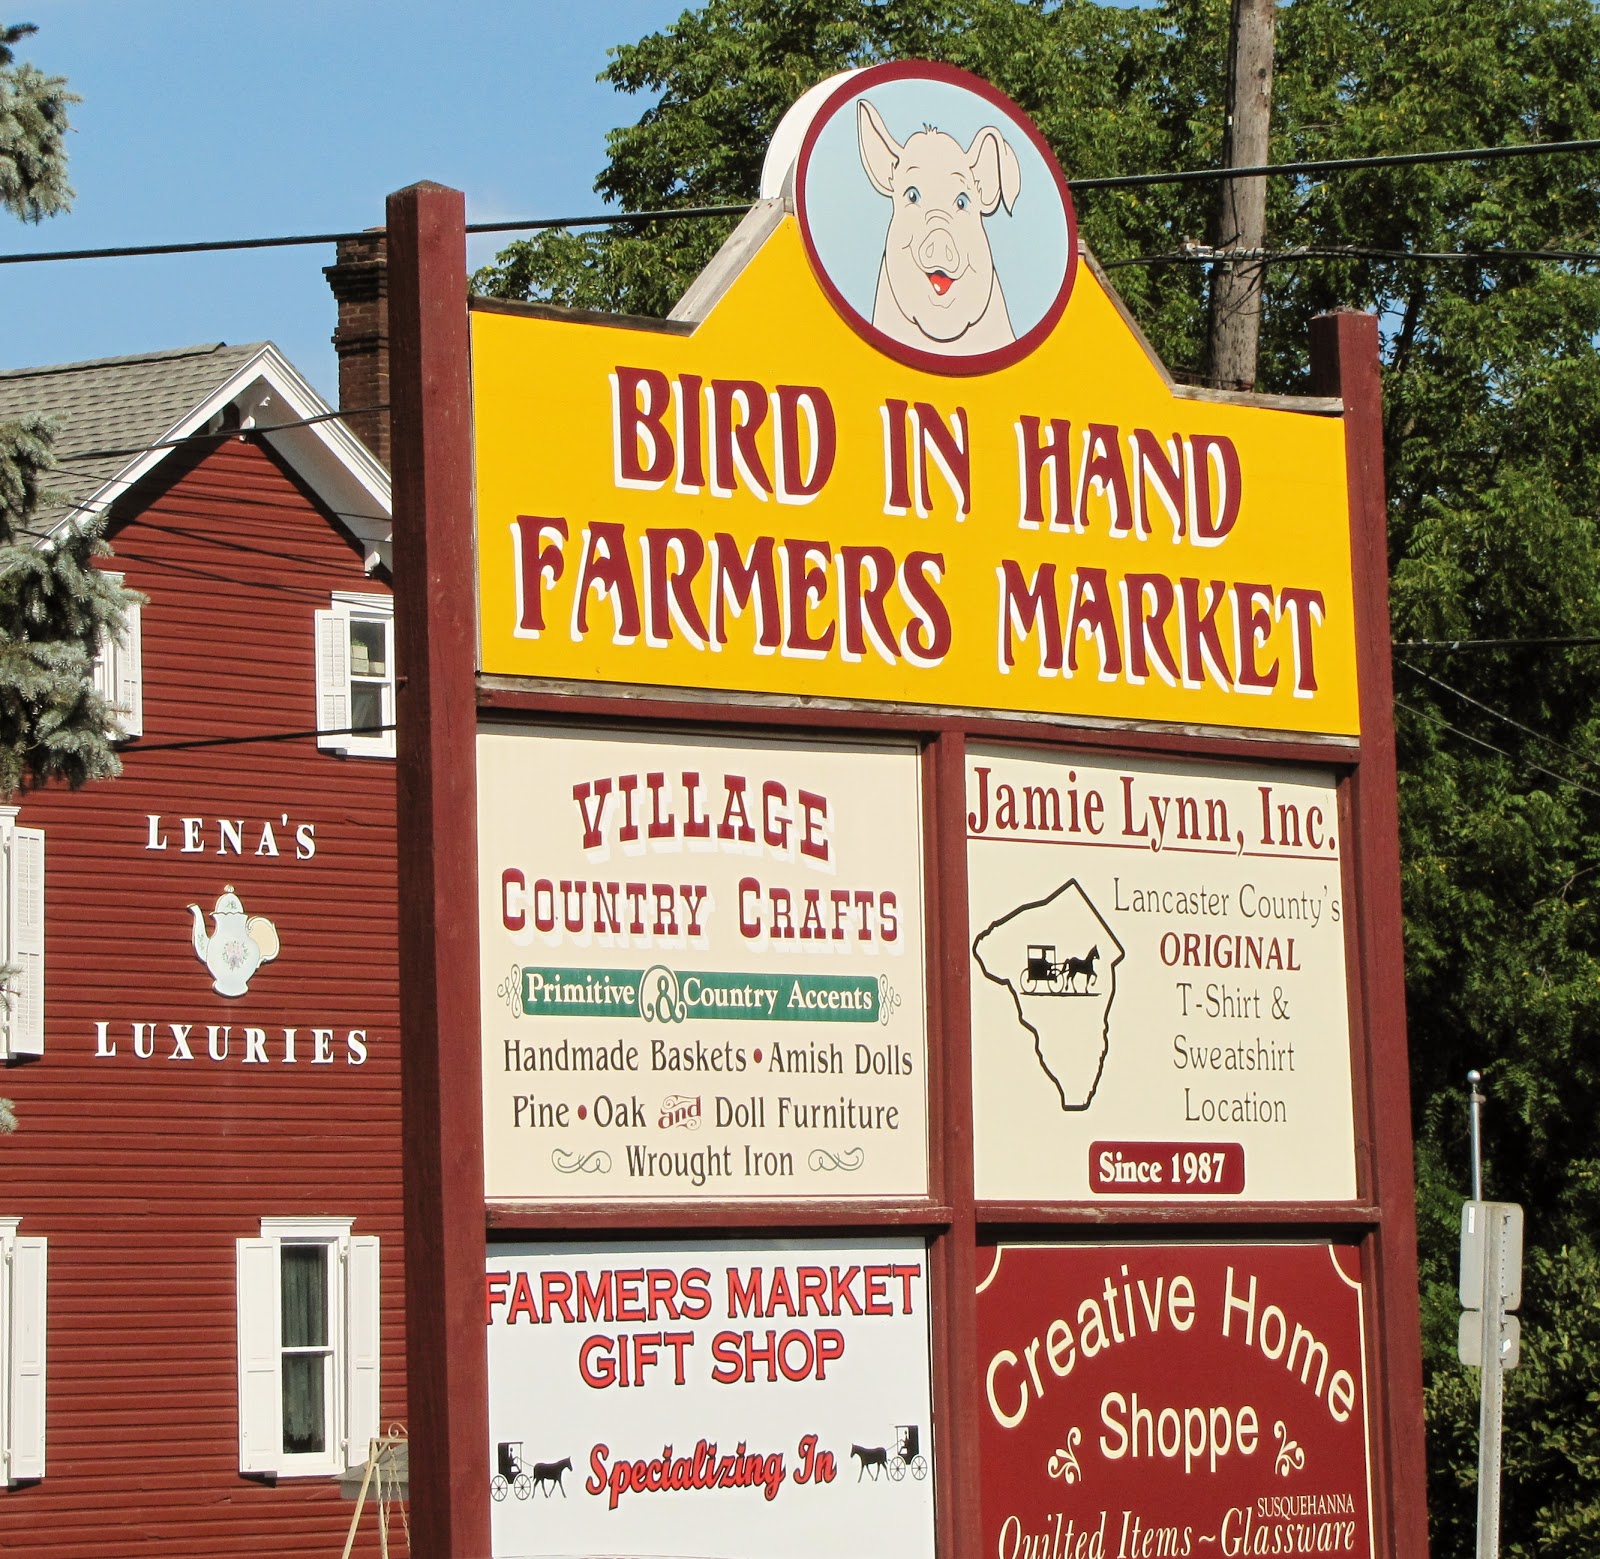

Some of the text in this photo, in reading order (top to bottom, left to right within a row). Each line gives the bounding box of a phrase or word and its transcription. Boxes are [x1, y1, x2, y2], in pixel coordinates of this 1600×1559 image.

[609, 366, 1242, 548] BIRD IN HAND
[510, 515, 1326, 699] FARMERS MARKET
[145, 814, 316, 860] LENA'S
[573, 772, 831, 866] VILLAGE
[968, 767, 1336, 856] Jamie Lynn, Inc.
[501, 868, 900, 946] COUNTRY CRAFTS
[1114, 877, 1341, 928] Lancaster County's
[1160, 932, 1301, 971] ORIGINAL
[525, 964, 873, 1023] Primitive & Country Accents
[1177, 982, 1291, 1020] T-Shirt &
[95, 1022, 368, 1065] LUXURIES
[504, 1039, 913, 1075] Handmade Baskets Amish Dolls
[1174, 1035, 1295, 1072] Sweatshirt
[513, 1094, 899, 1130] Pine Oak and Doll Furniture
[1185, 1088, 1288, 1123] Location
[626, 1145, 794, 1186] Wrought Iron
[1099, 1152, 1226, 1183] Since 1987
[486, 1264, 921, 1325] FARMERS MARKET
[579, 1329, 845, 1389] GIFT SHOP
[986, 1264, 1356, 1428] Creative Home
[1100, 1391, 1259, 1474] Shoppe
[586, 1434, 837, 1511] Specializing In
[999, 1511, 1106, 1559] Quilted
[1117, 1510, 1193, 1558] Items
[1221, 1506, 1355, 1557] Glassware
[1257, 1494, 1355, 1519] SUSQUEHANNA
